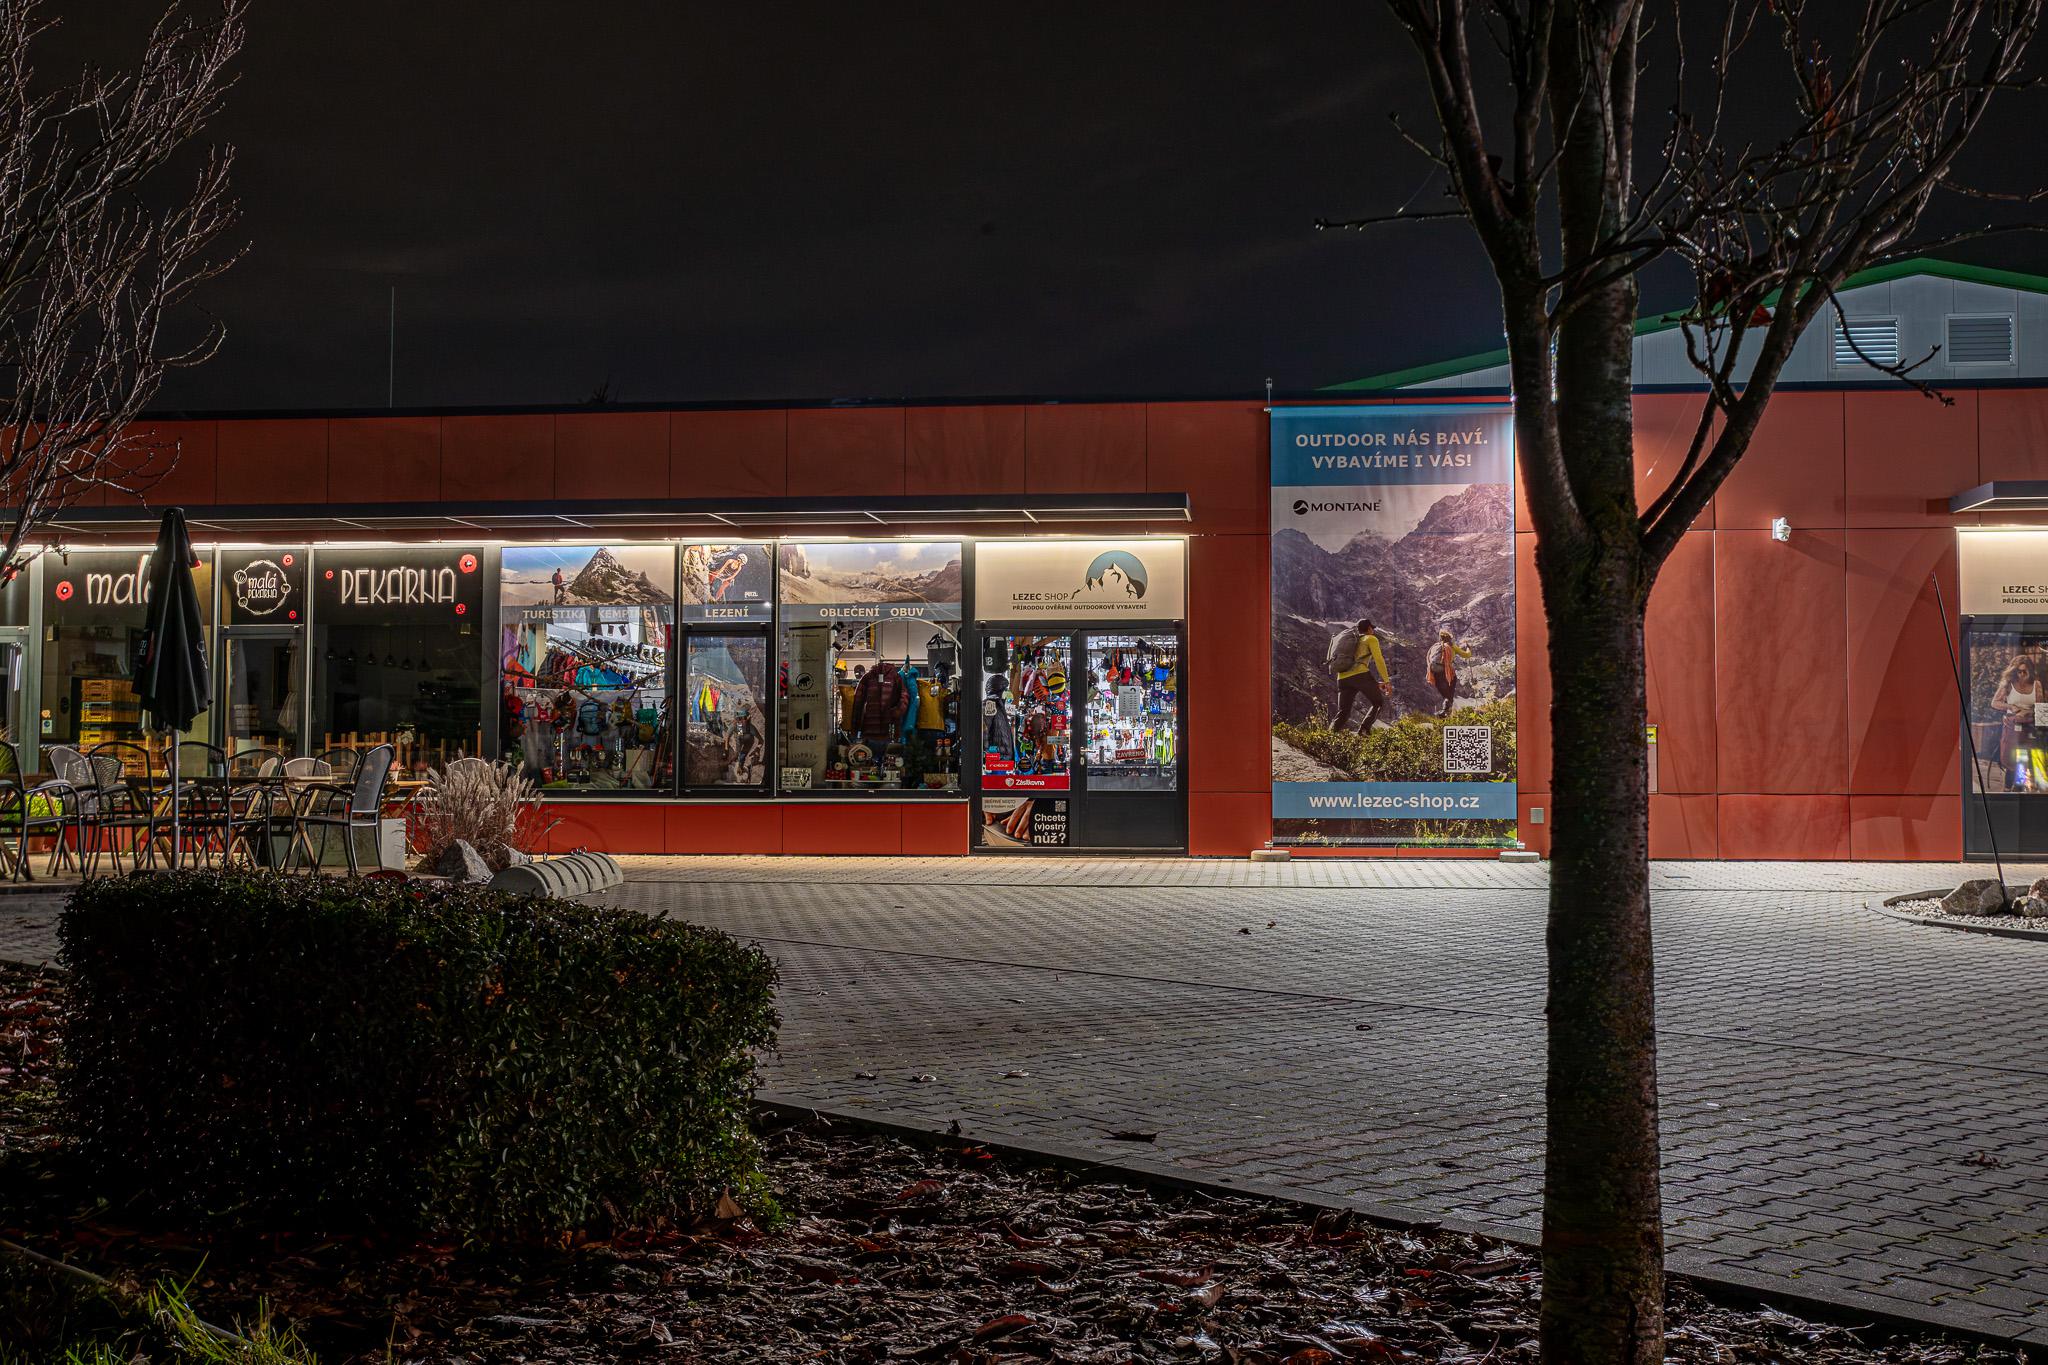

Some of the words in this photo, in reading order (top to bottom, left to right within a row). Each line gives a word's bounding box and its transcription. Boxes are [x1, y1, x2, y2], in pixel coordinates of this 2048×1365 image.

[1295, 433, 1387, 447] OUTDOOR
[1393, 429, 1430, 446] NÁS
[1436, 428, 1488, 445] BAVÍ.
[1312, 451, 1409, 469] VYBAVÍME
[1415, 454, 1423, 468] I
[1430, 450, 1472, 467] VÁS!
[1311, 502, 1380, 512] MONTANE
[248, 571, 277, 589] malá
[341, 566, 456, 604] PEKÁRNA
[2002, 585, 2035, 594] LEZEC
[1012, 593, 1042, 601] LEZEC
[1044, 592, 1069, 601] SHOP
[705, 605, 749, 618] LEZENÍ
[820, 604, 879, 618] OBLEČENÍ
[890, 607, 924, 617] OBUV
[1012, 603, 1044, 611] PŘÍRODOU
[523, 609, 586, 619] TURISTIKA
[597, 609, 651, 619] KEMPING
[789, 733, 817, 741] deuter
[1116, 750, 1145, 758] ZAVŘENO
[1309, 793, 1479, 811] www.lezec-shop.cz
[1034, 813, 1066, 822] Chcete
[1034, 822, 1066, 832] (v)ostrý
[1034, 831, 1066, 844] nůž?
